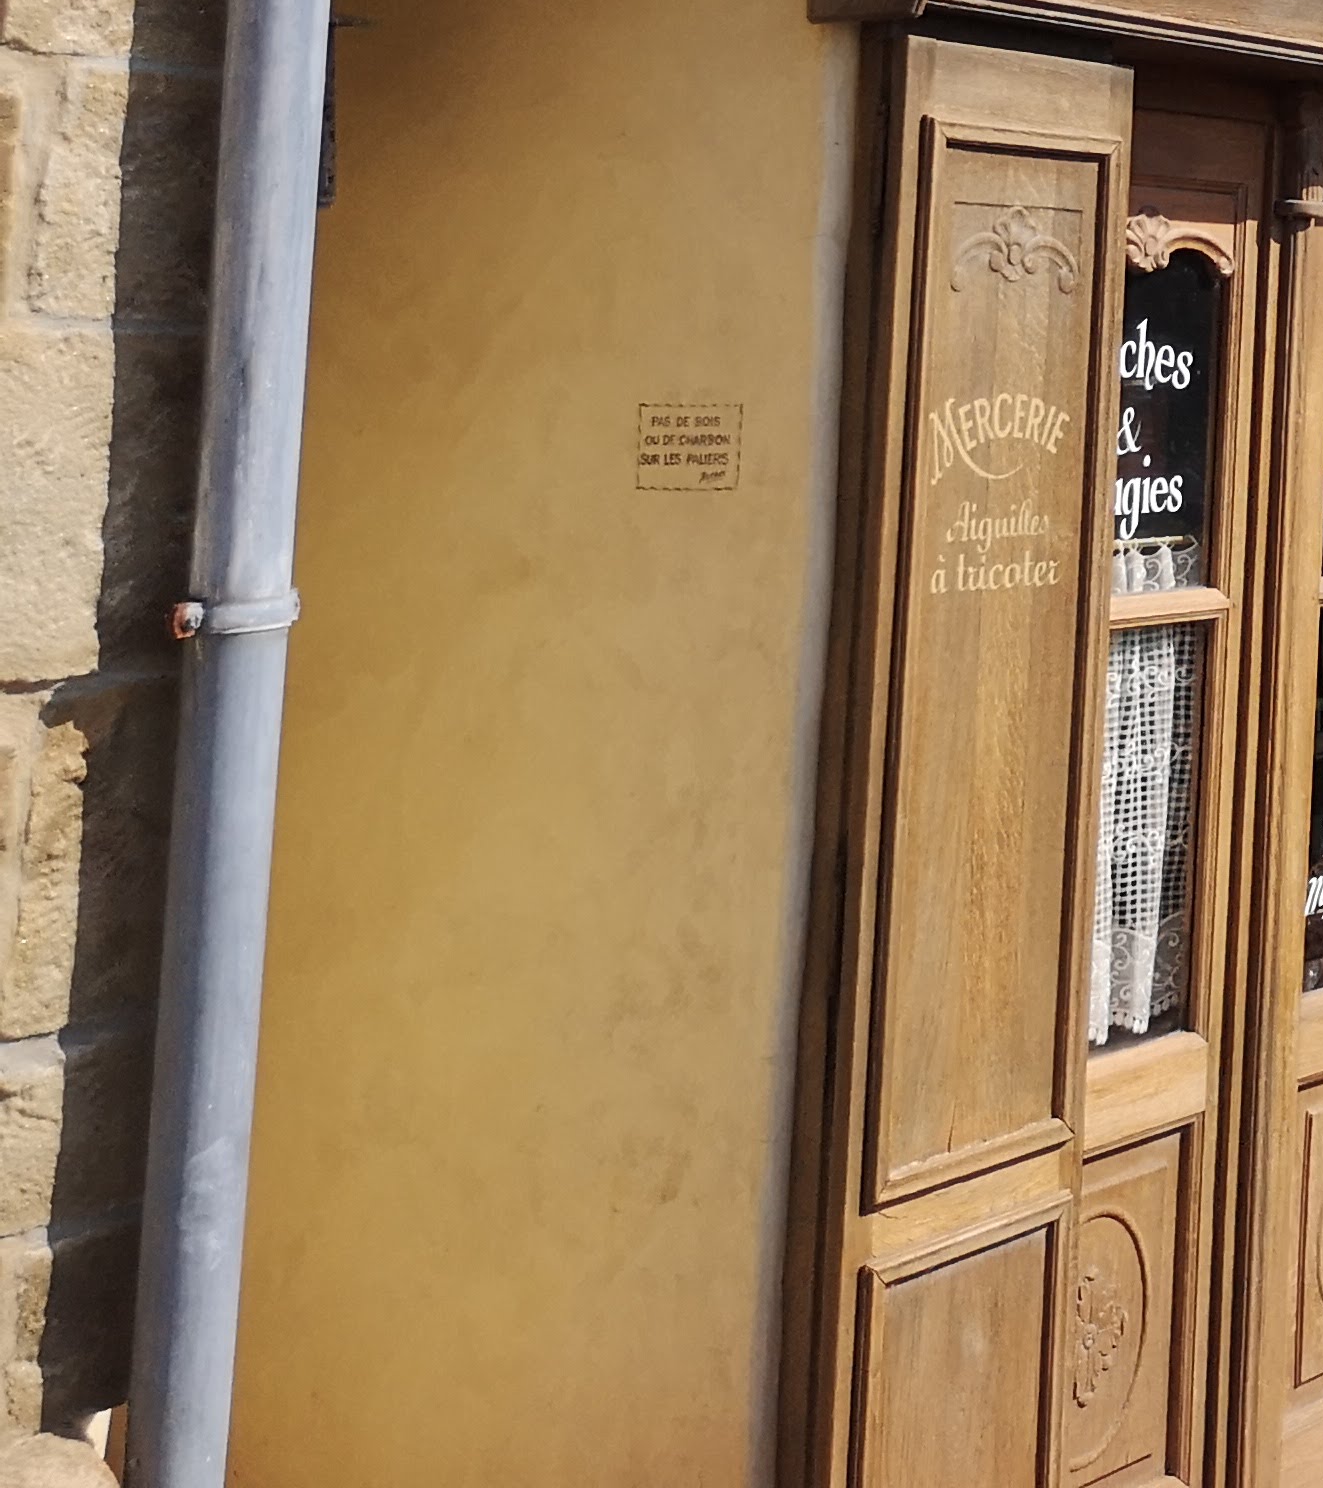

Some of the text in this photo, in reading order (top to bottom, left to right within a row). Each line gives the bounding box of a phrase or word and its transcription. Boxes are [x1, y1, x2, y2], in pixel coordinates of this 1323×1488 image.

[644, 434, 731, 446] OU DE CHARBON
[651, 416, 721, 428] PAS DE BOIS
[929, 393, 1070, 486] MERCERIE
[1116, 406, 1142, 454] &
[640, 453, 729, 465] SUR LES PALIERS
[946, 499, 1050, 553] Aiguilles
[931, 553, 1061, 595] à tricoter
